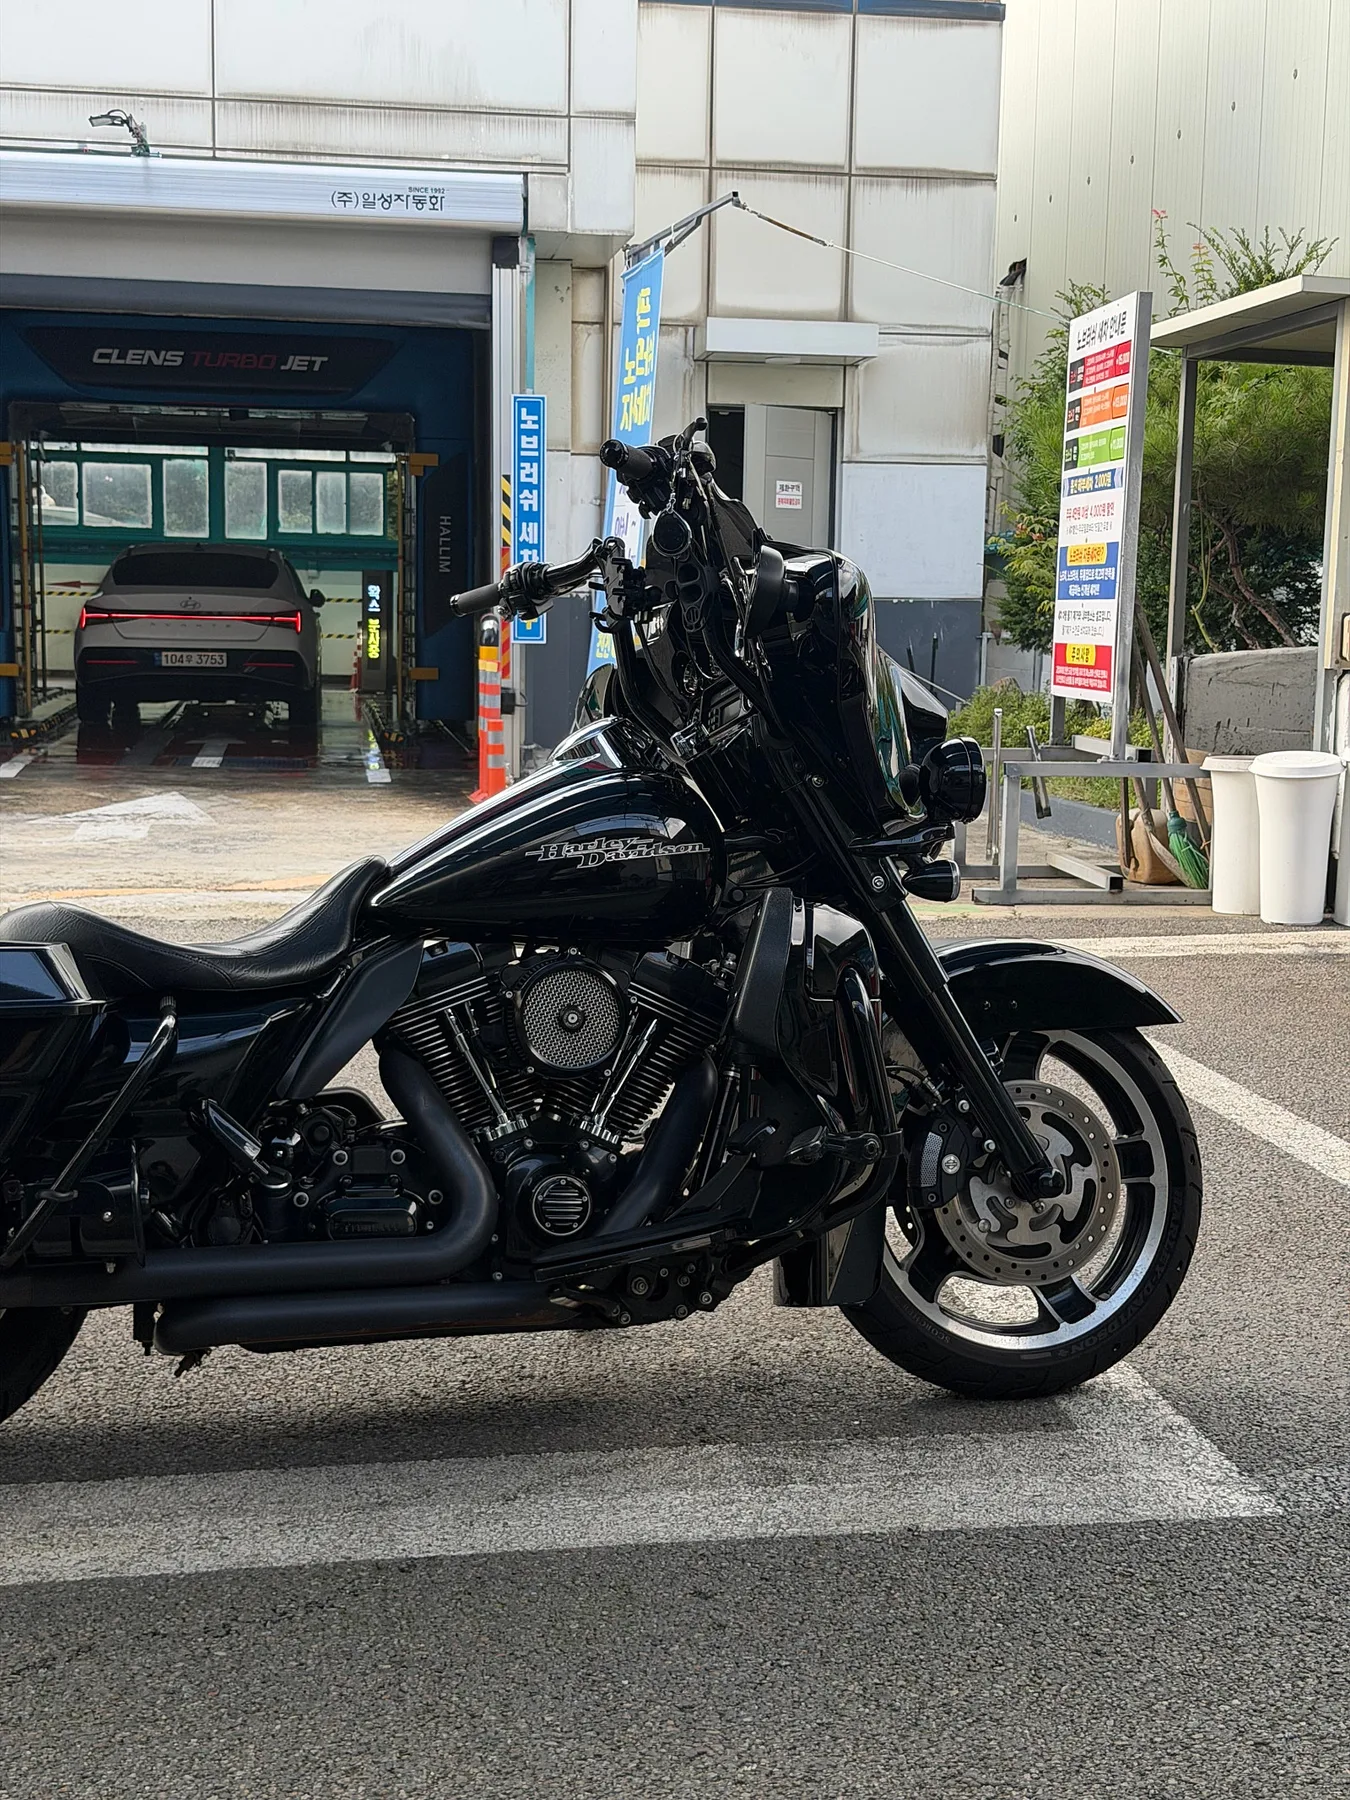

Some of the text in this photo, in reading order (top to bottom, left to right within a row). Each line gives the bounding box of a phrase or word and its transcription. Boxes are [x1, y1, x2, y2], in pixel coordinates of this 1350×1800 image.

[331, 190, 445, 211] (주)일성자동화
[1076, 322, 1097, 351] 노브러쉬
[1097, 317, 1108, 343] 세차
[92, 348, 329, 372] CLENS TURBO JET
[518, 407, 540, 512] 노브러쉬
[439, 516, 451, 573] HALLIM
[367, 584, 381, 612] 왁스
[163, 654, 224, 665] 104우 3753
[1071, 646, 1090, 663] 주의사항
[577, 842, 710, 869] Davidson
